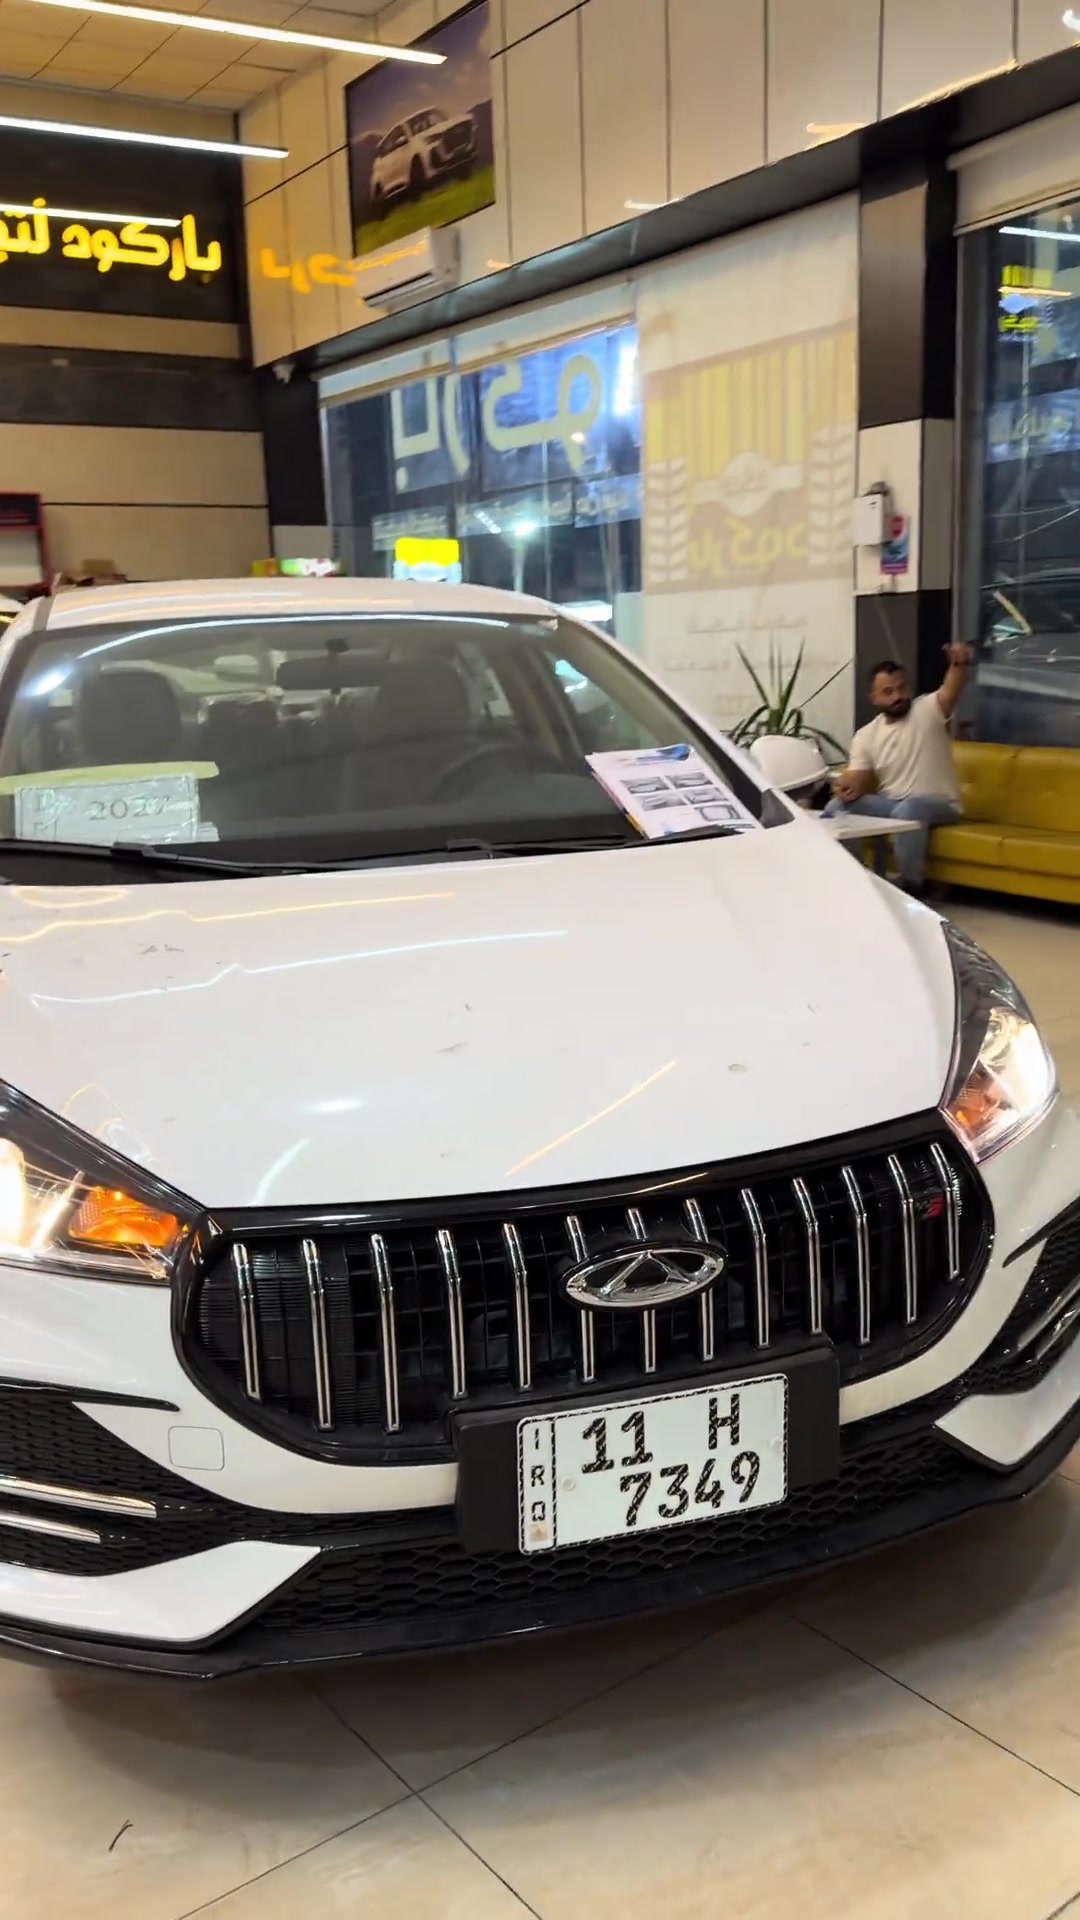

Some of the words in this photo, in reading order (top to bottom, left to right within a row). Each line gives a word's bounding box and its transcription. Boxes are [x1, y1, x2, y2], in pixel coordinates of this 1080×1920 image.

[581, 1410, 654, 1474] 11
[708, 1393, 740, 1451] H
[619, 1450, 761, 1527] 7349
